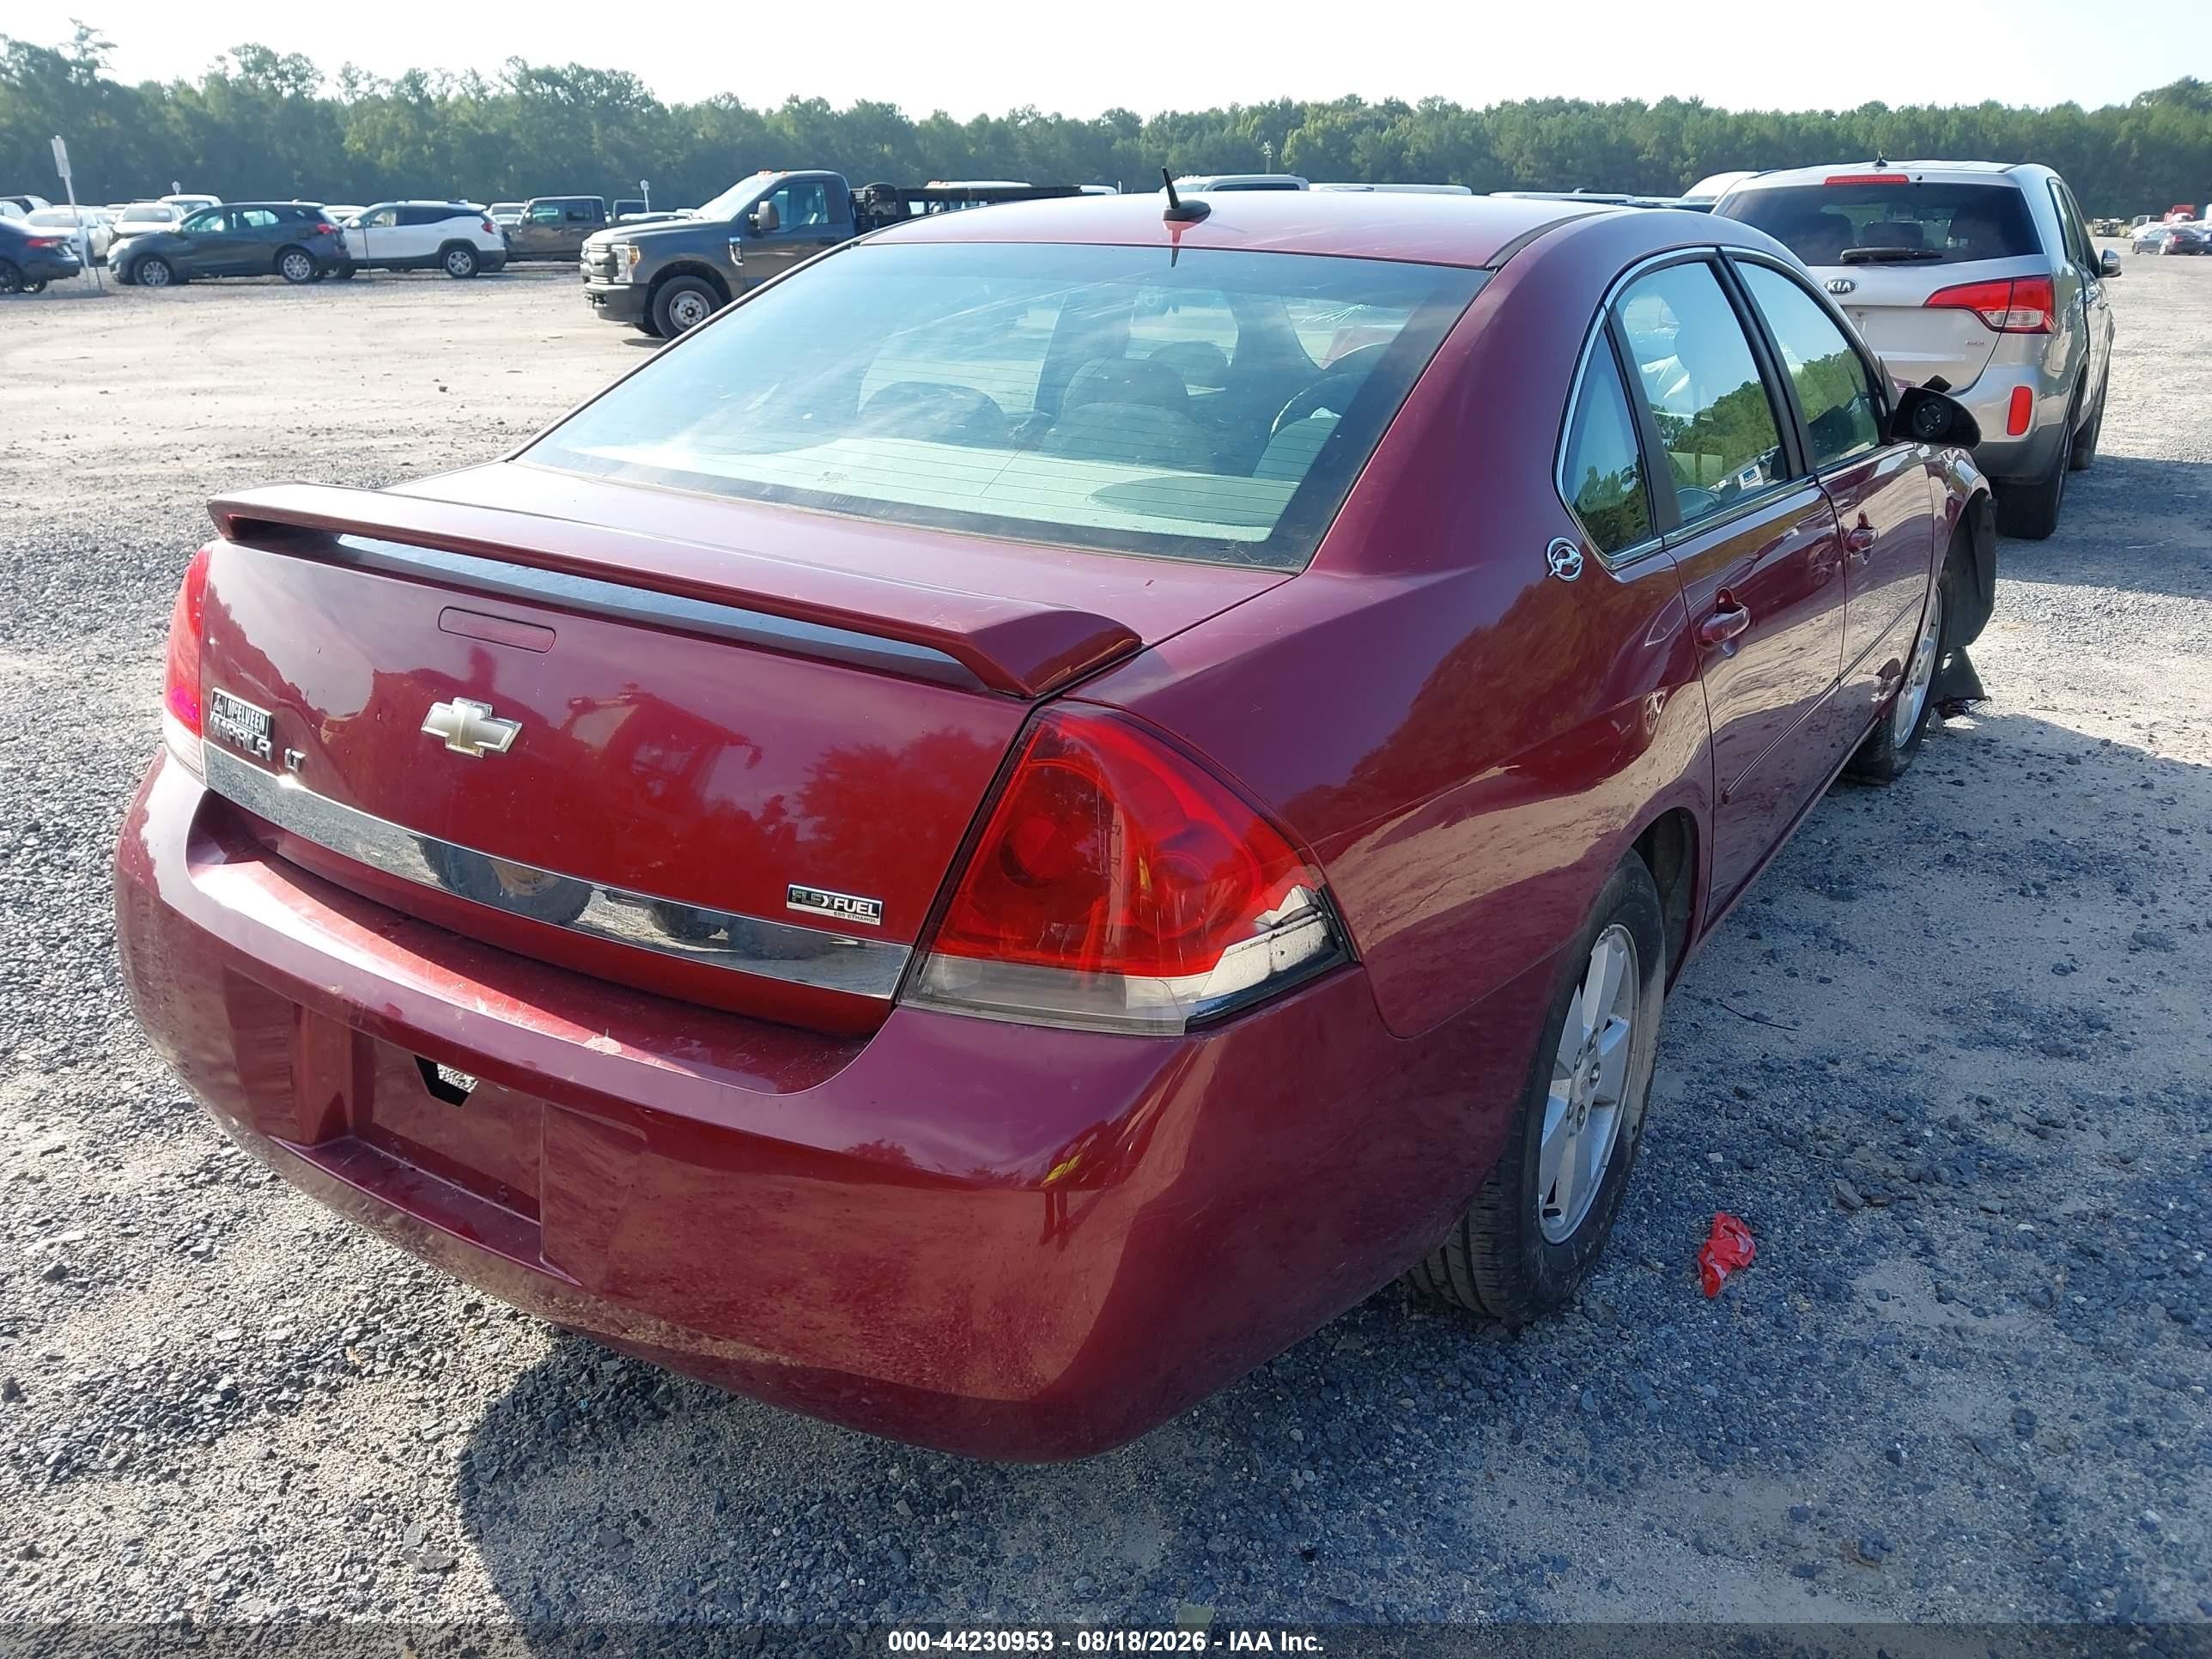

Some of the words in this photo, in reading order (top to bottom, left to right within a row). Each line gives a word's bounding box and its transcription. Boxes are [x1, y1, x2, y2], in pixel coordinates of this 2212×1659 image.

[1826, 281, 1851, 293] KIA
[284, 748, 306, 772] LT
[792, 890, 878, 917] FLEXFUEL
